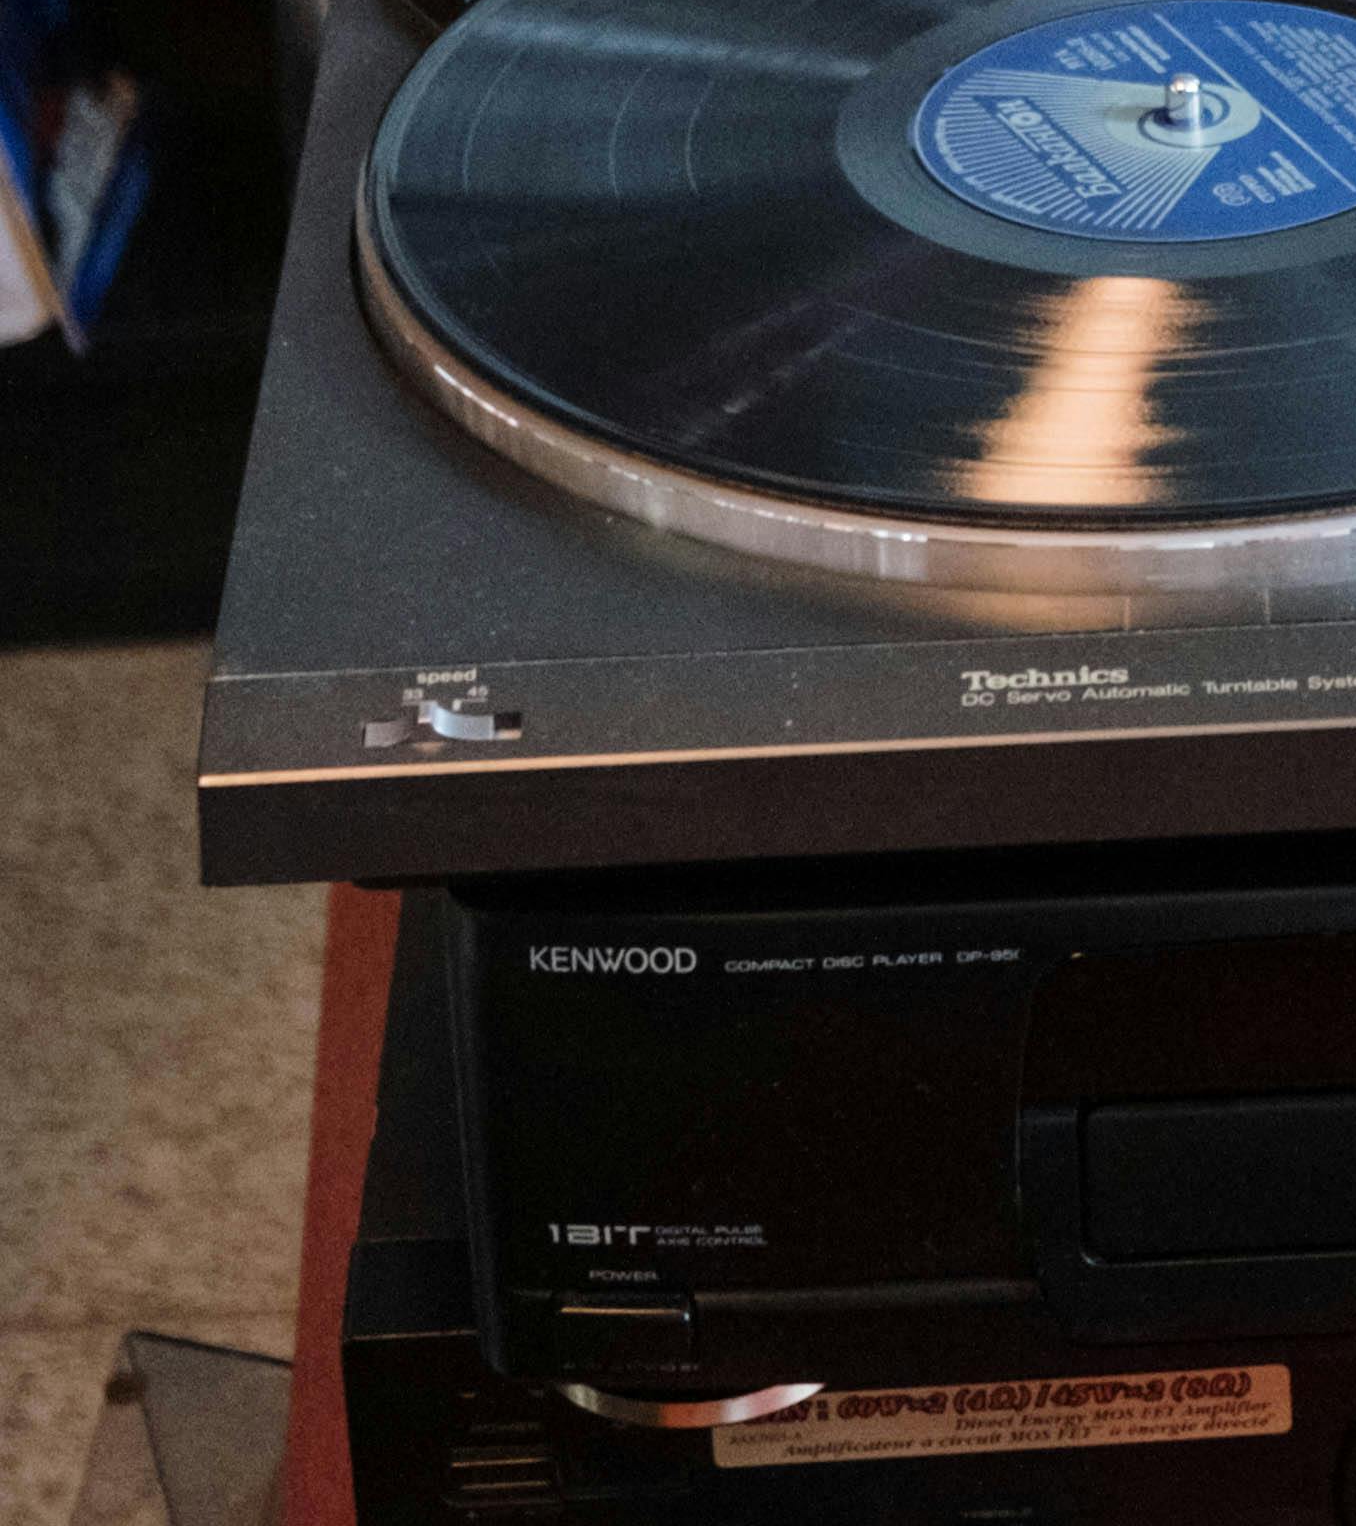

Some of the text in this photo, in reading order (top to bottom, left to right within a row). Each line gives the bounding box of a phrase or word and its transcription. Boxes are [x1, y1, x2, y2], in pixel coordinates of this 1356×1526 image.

[416, 668, 478, 686] speed
[961, 665, 1130, 693] Technics
[961, 692, 995, 707] DC
[1006, 689, 1072, 705] Servo
[1081, 682, 1191, 702] Automatic
[1202, 677, 1298, 695] Turntable
[528, 946, 944, 975] KENWOOD COMPACT DISC PLAYER
[654, 1223, 765, 1236] DIGITAL PULSE
[694, 1236, 769, 1247] CONTROL
[587, 1269, 660, 1282] POWER
[954, 1414, 1014, 1431] Direct
[1020, 1409, 1091, 1428] Energy
[1094, 1406, 1136, 1423] MOS
[1183, 1399, 1271, 1418] Amplifier
[783, 1436, 921, 1459] Amplificateur
